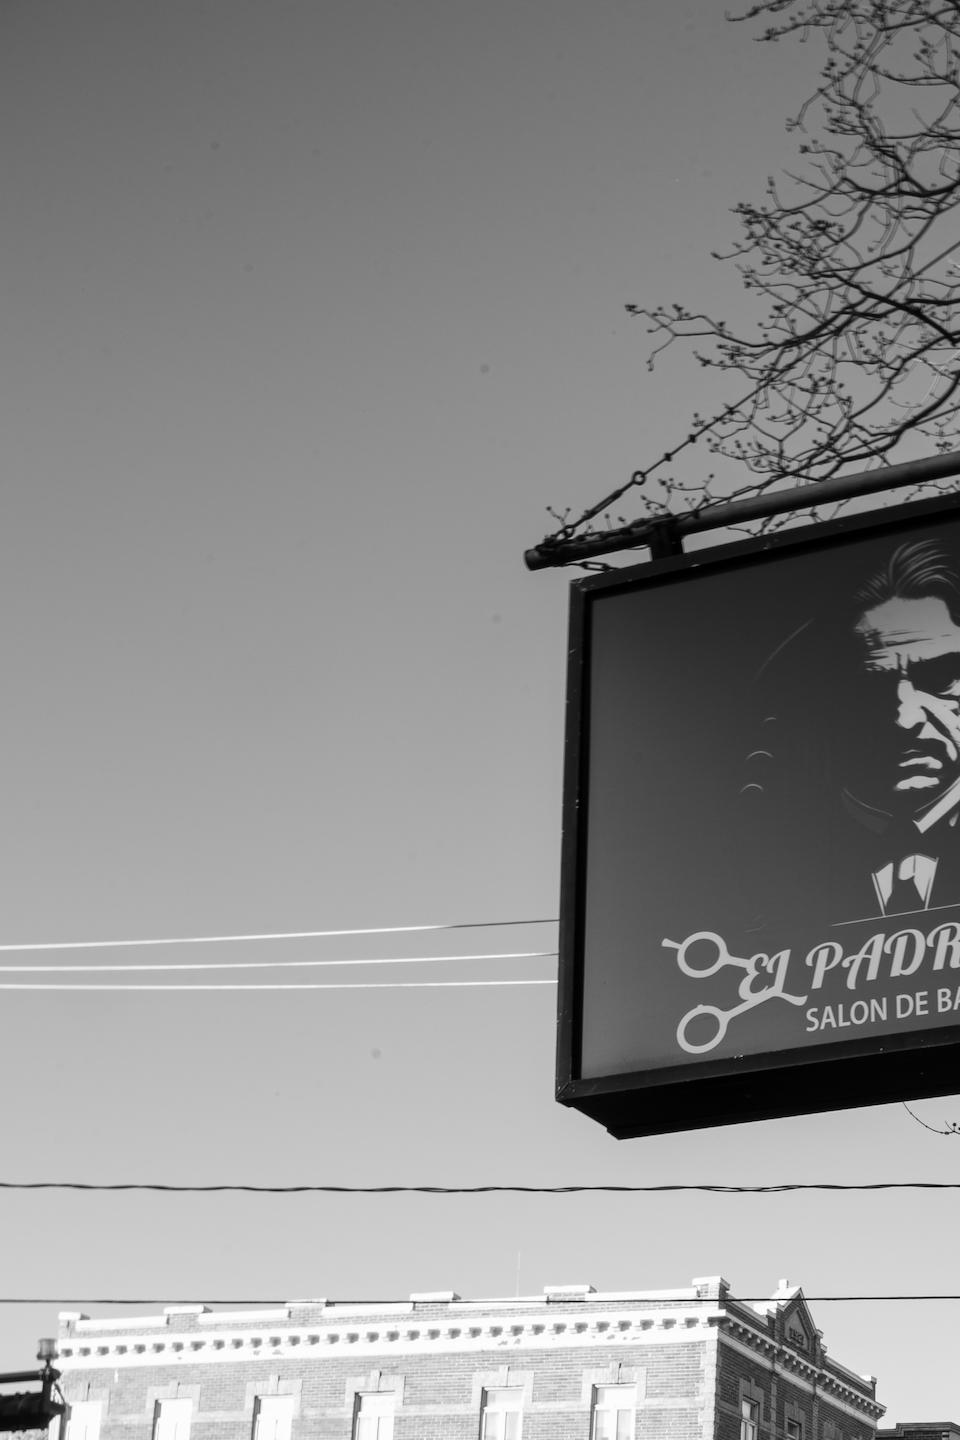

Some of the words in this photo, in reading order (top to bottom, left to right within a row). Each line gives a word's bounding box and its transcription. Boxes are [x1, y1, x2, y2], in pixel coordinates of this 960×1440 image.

[738, 949, 808, 1006] EL
[805, 992, 889, 1032] SALON
[896, 988, 929, 1016] DE
